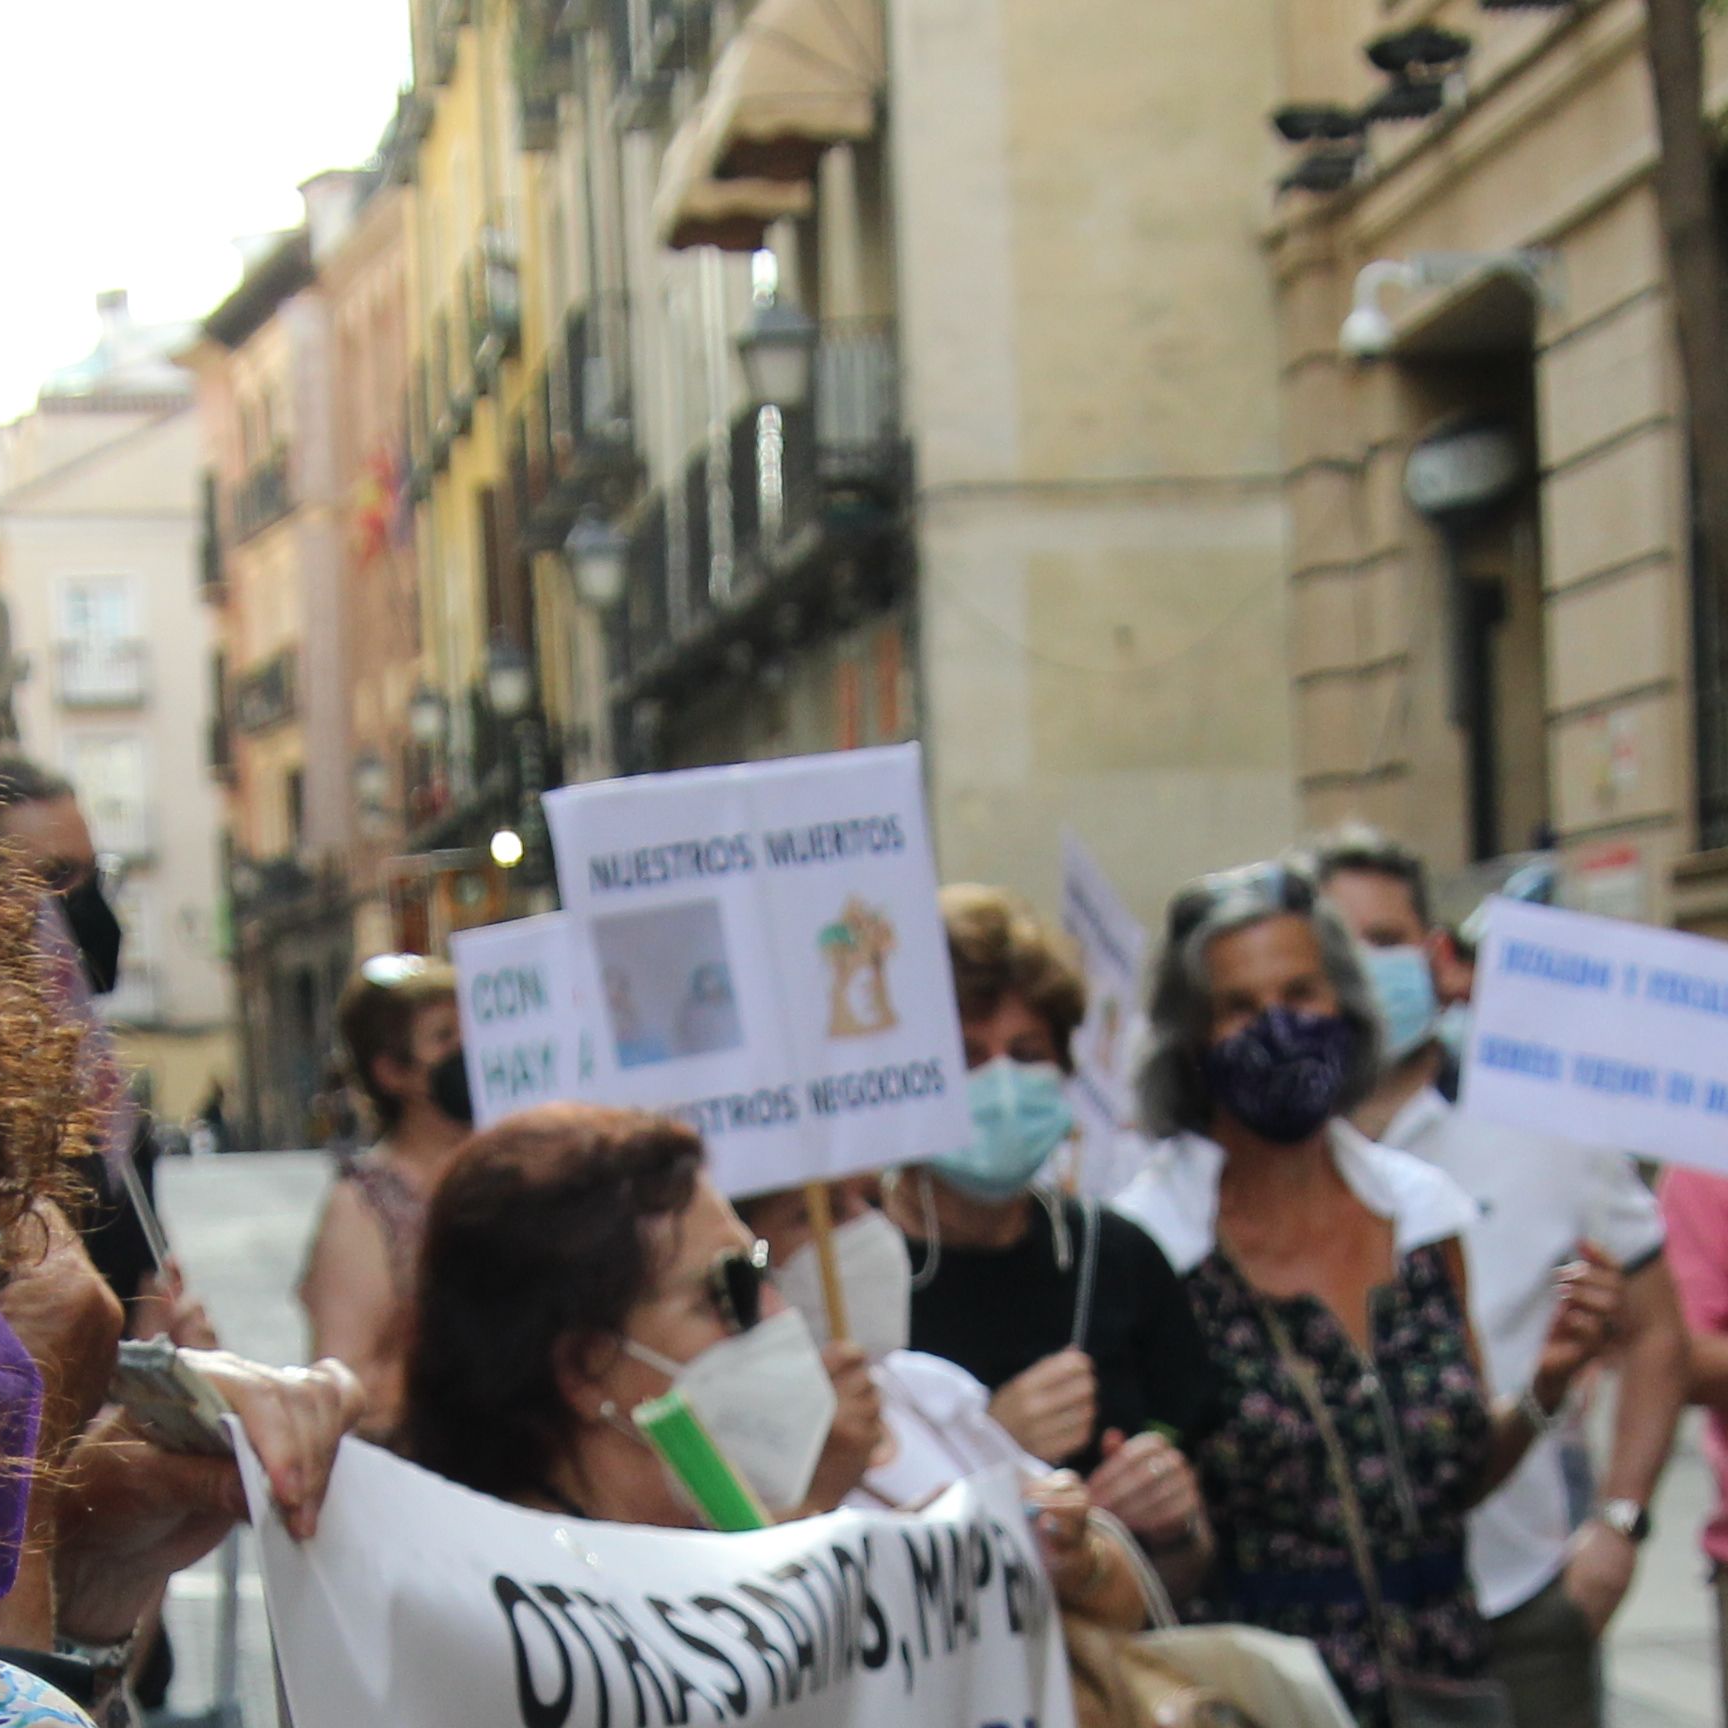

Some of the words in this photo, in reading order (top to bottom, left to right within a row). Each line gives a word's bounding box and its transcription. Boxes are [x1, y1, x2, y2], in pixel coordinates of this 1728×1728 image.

[588, 832, 757, 892] NUESTROS
[764, 812, 906, 867] MUERTOS
[472, 960, 552, 1027] CON
[806, 1056, 946, 1118] NEGOCIOS
